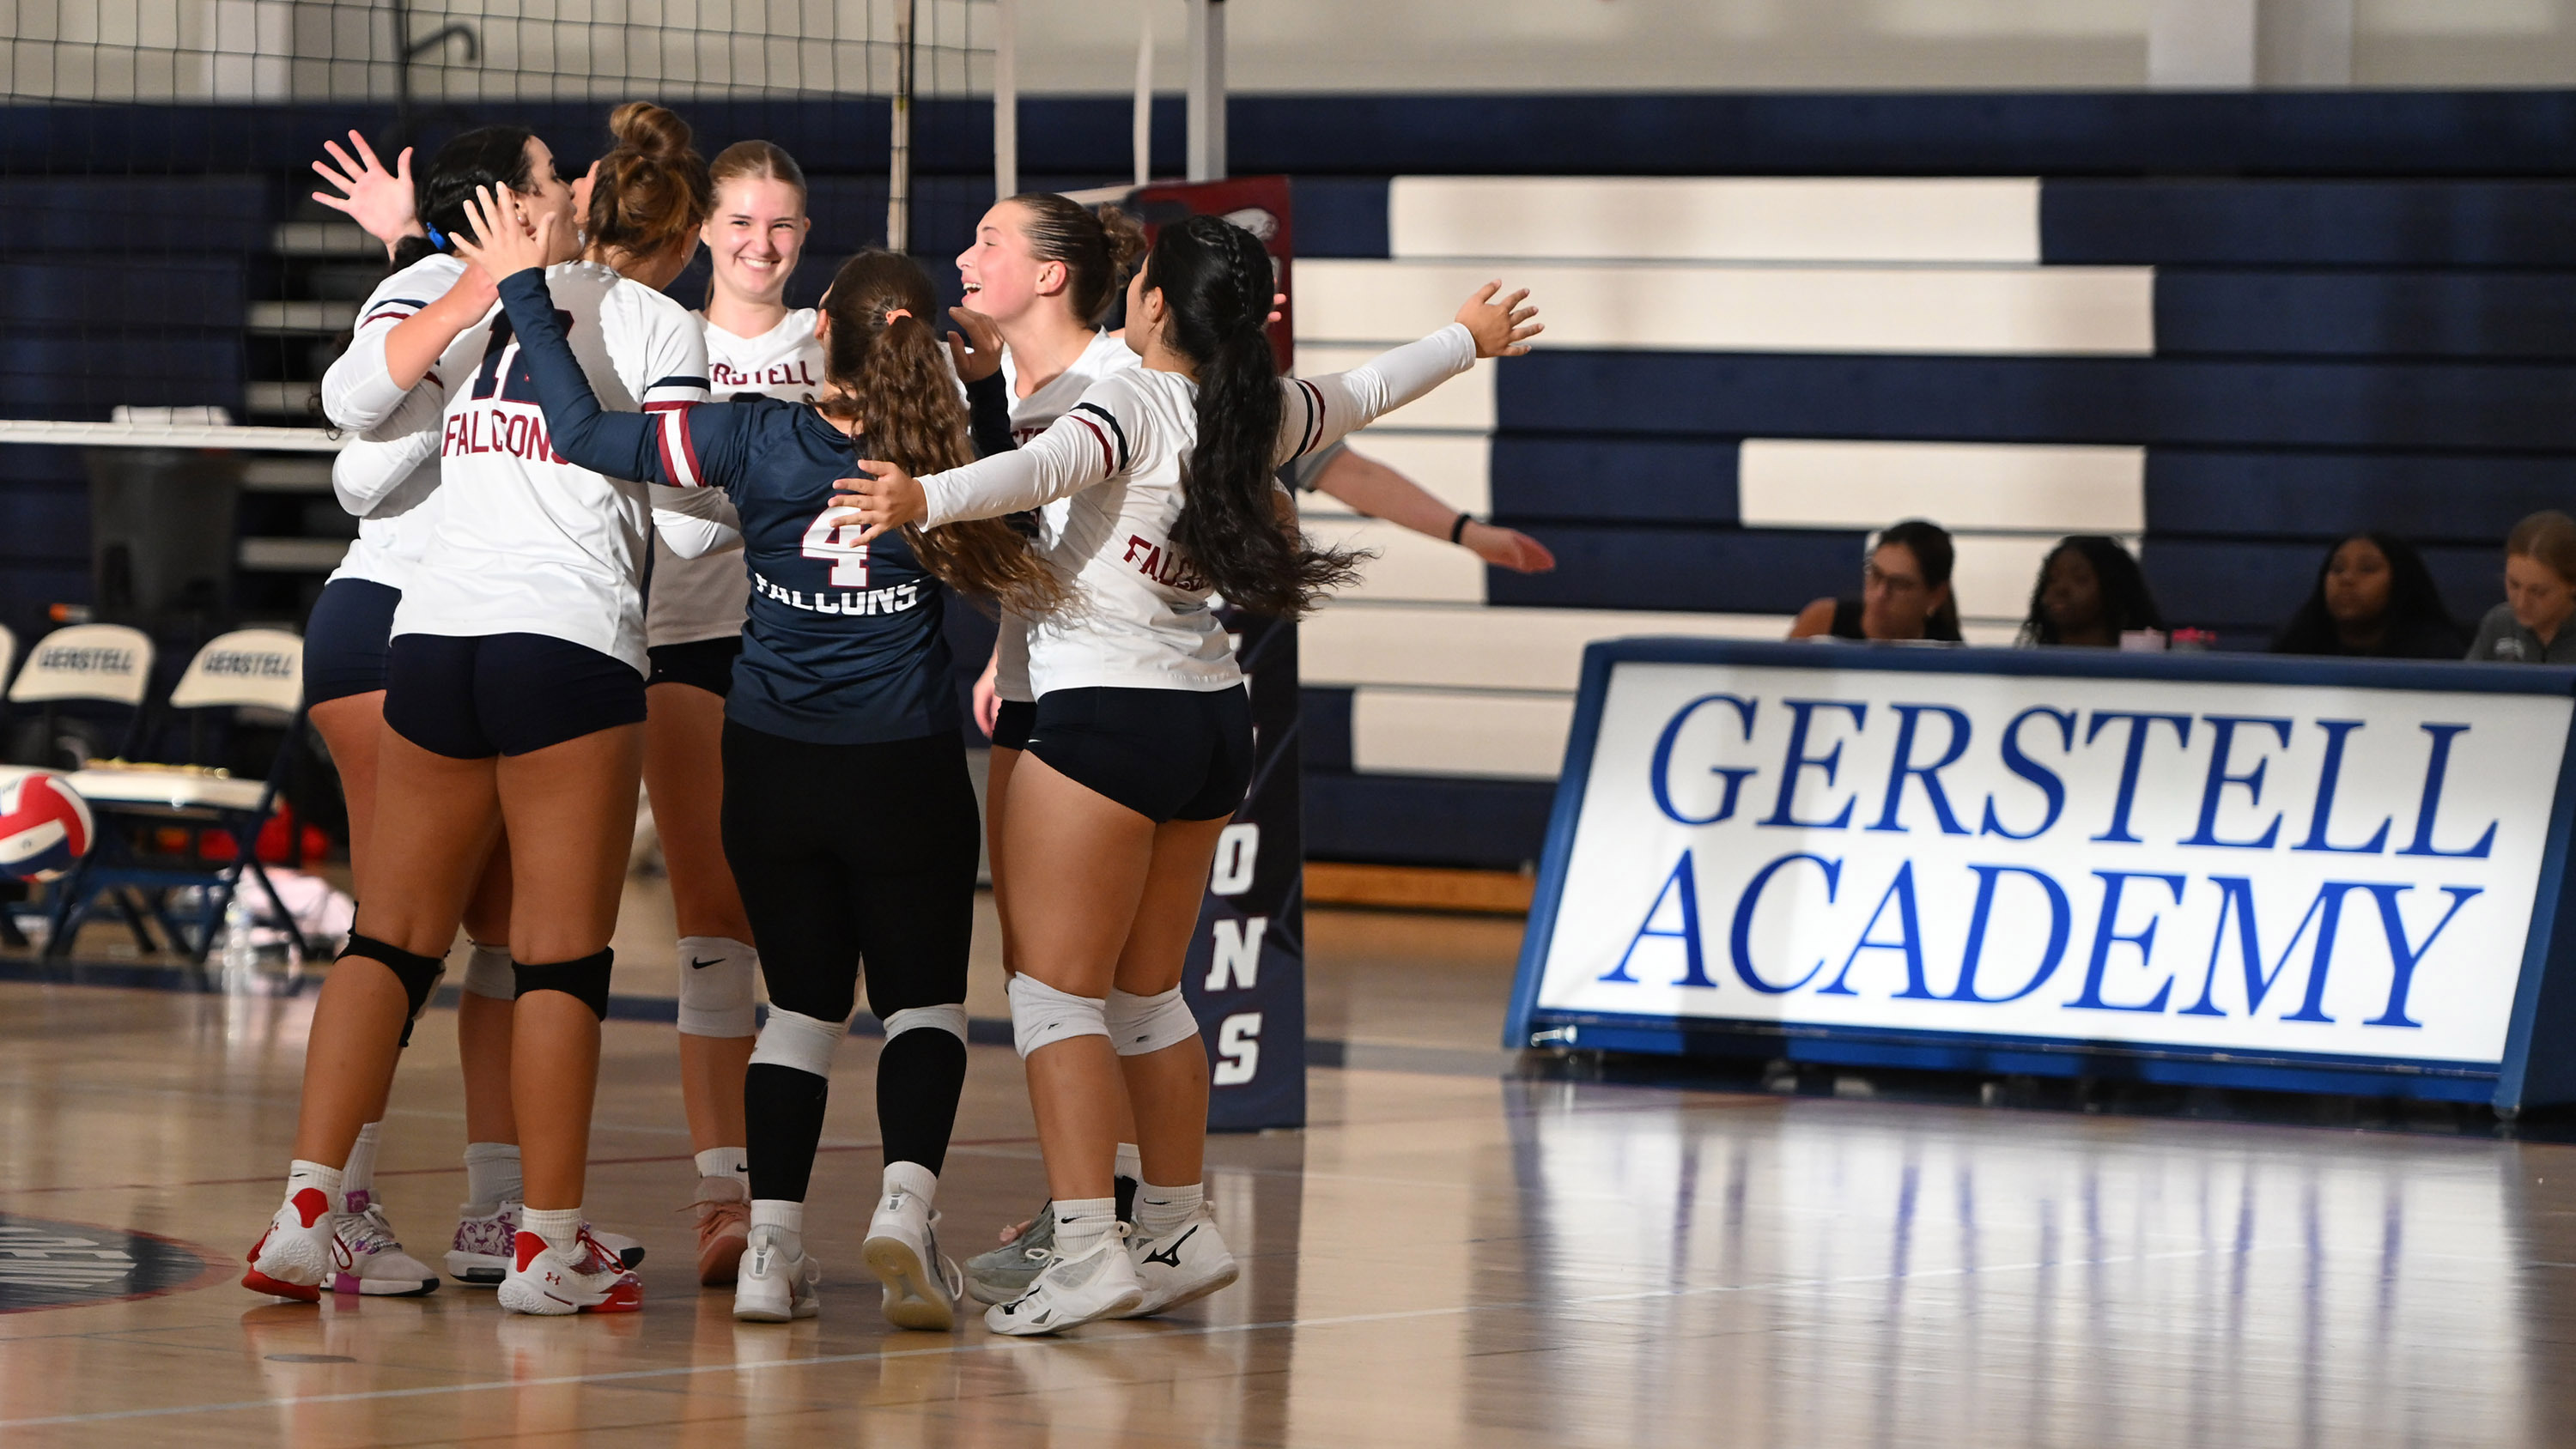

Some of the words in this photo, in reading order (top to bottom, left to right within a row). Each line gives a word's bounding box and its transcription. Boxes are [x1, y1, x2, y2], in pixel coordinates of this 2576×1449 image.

[708, 360, 816, 386] RSTELL
[441, 409, 570, 465] FALCON
[799, 494, 870, 587] 4
[755, 573, 920, 615] FALCONS
[1649, 693, 2499, 858] GERSTELL
[1599, 848, 2483, 1028] ACADEMY
